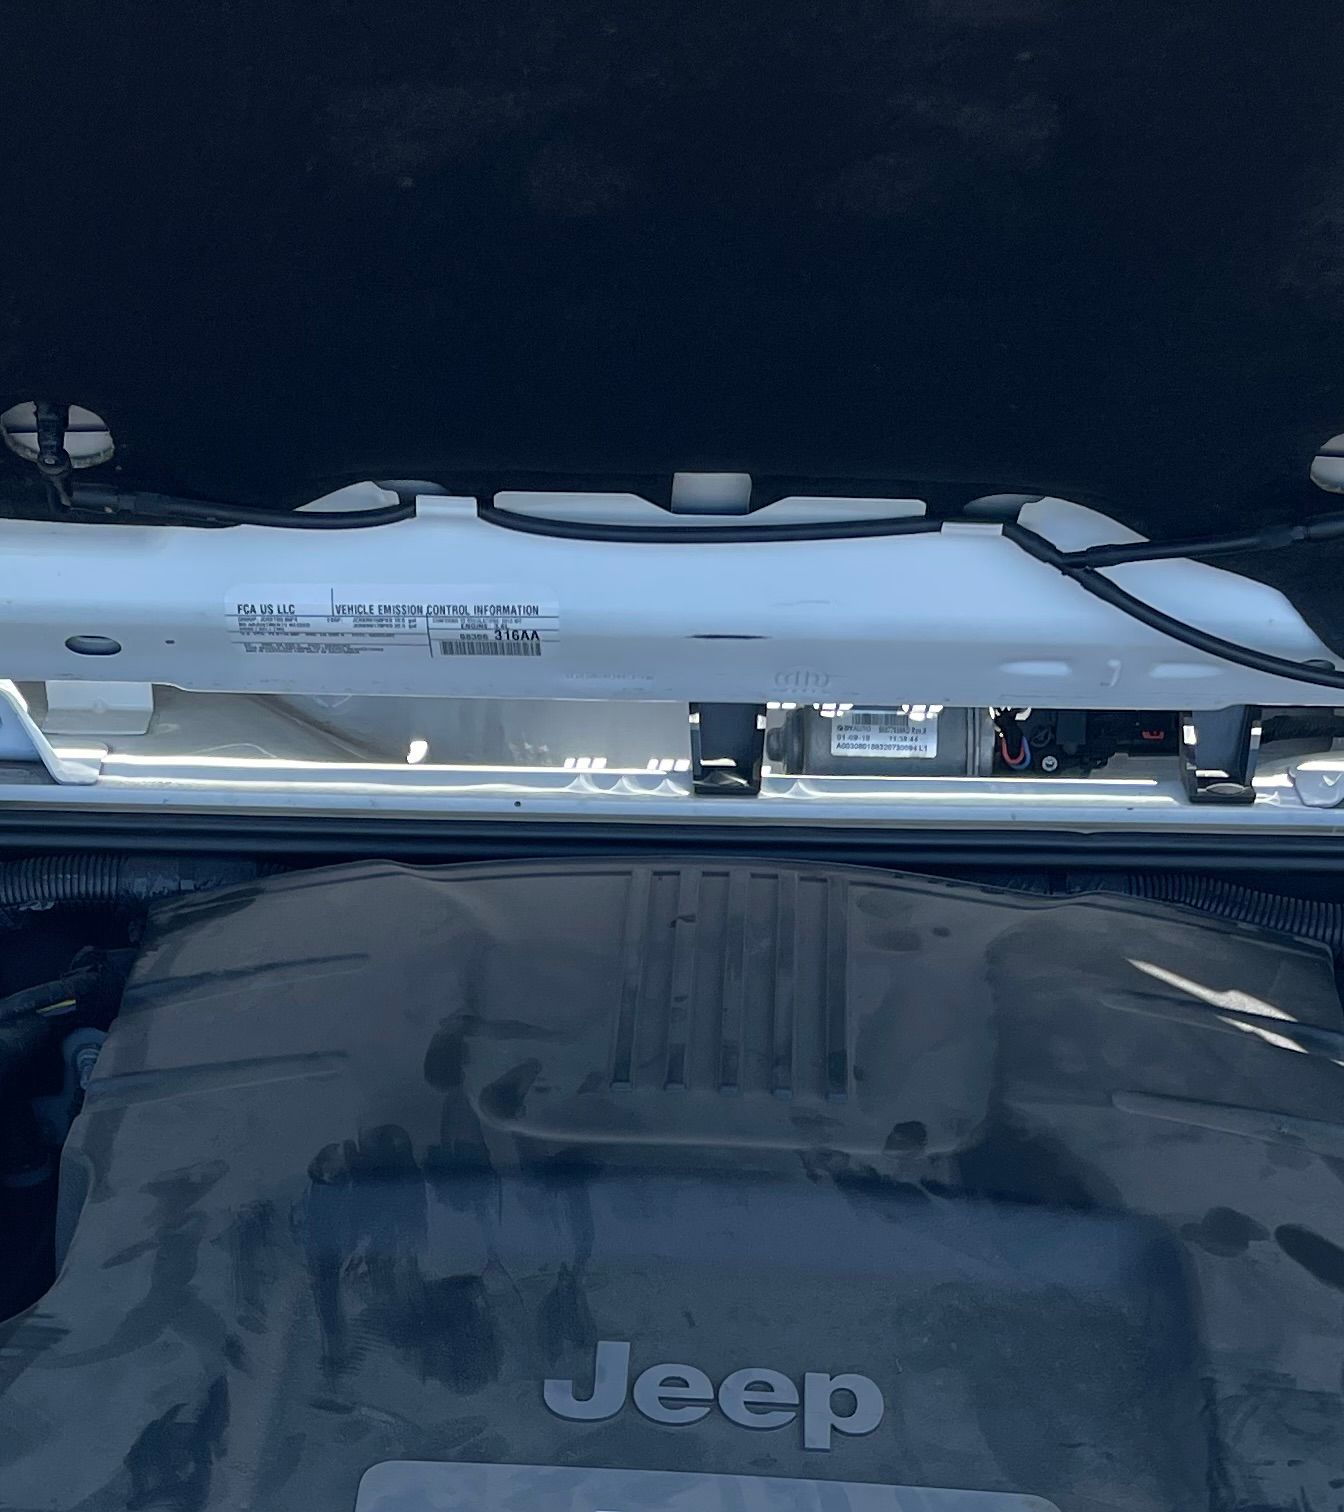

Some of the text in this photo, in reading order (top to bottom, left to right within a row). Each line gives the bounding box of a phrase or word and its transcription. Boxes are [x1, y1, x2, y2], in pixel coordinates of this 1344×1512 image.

[237, 604, 295, 615] FCA US LLC
[335, 604, 539, 616] VEHICLE EMISSION CONTROL INFORMATION
[494, 629, 541, 641] 316AA
[543, 1341, 884, 1451] Jeep
